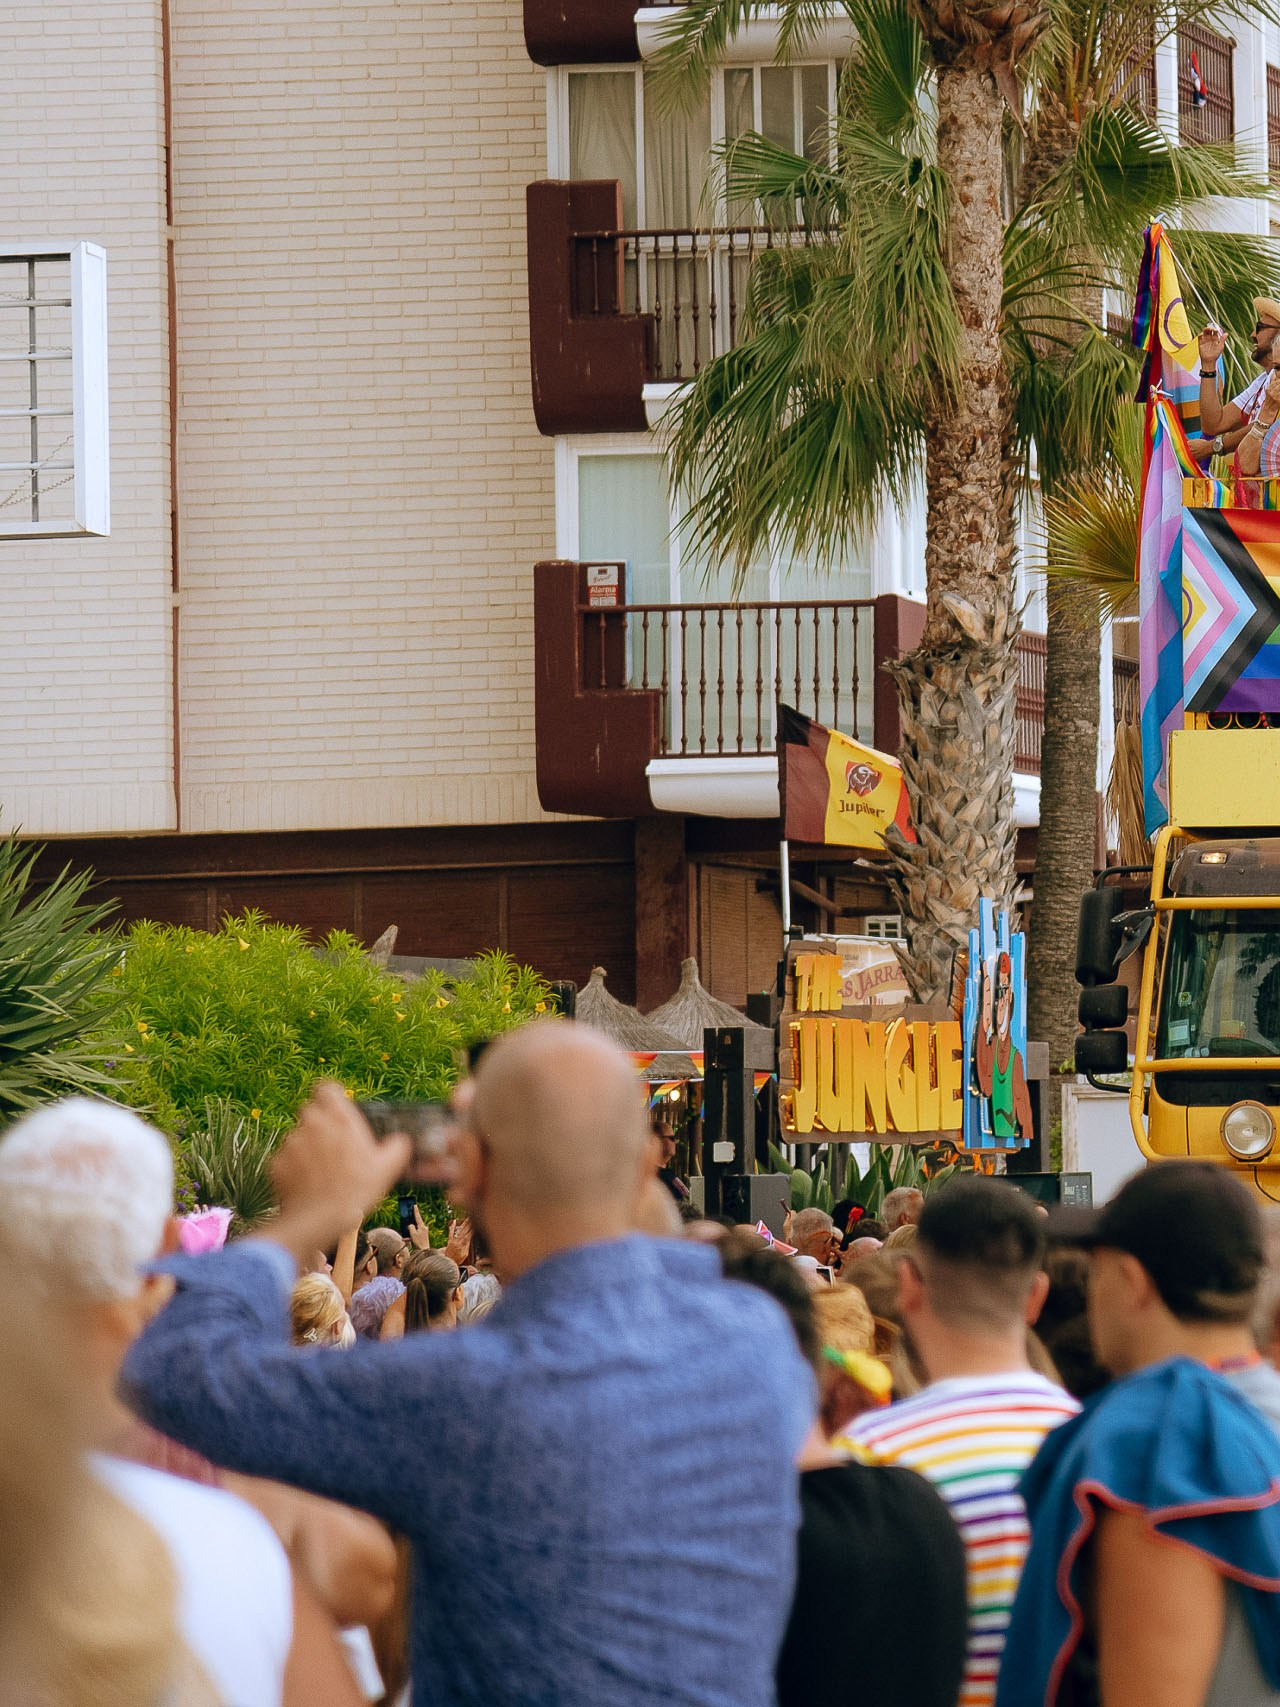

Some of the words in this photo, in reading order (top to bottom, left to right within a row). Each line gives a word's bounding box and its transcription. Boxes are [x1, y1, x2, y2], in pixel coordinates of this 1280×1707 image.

[839, 799, 886, 818] Jupiler
[795, 955, 843, 1012] THE
[855, 964, 904, 1000] JARRA
[793, 1017, 963, 1134] JUNGLE
